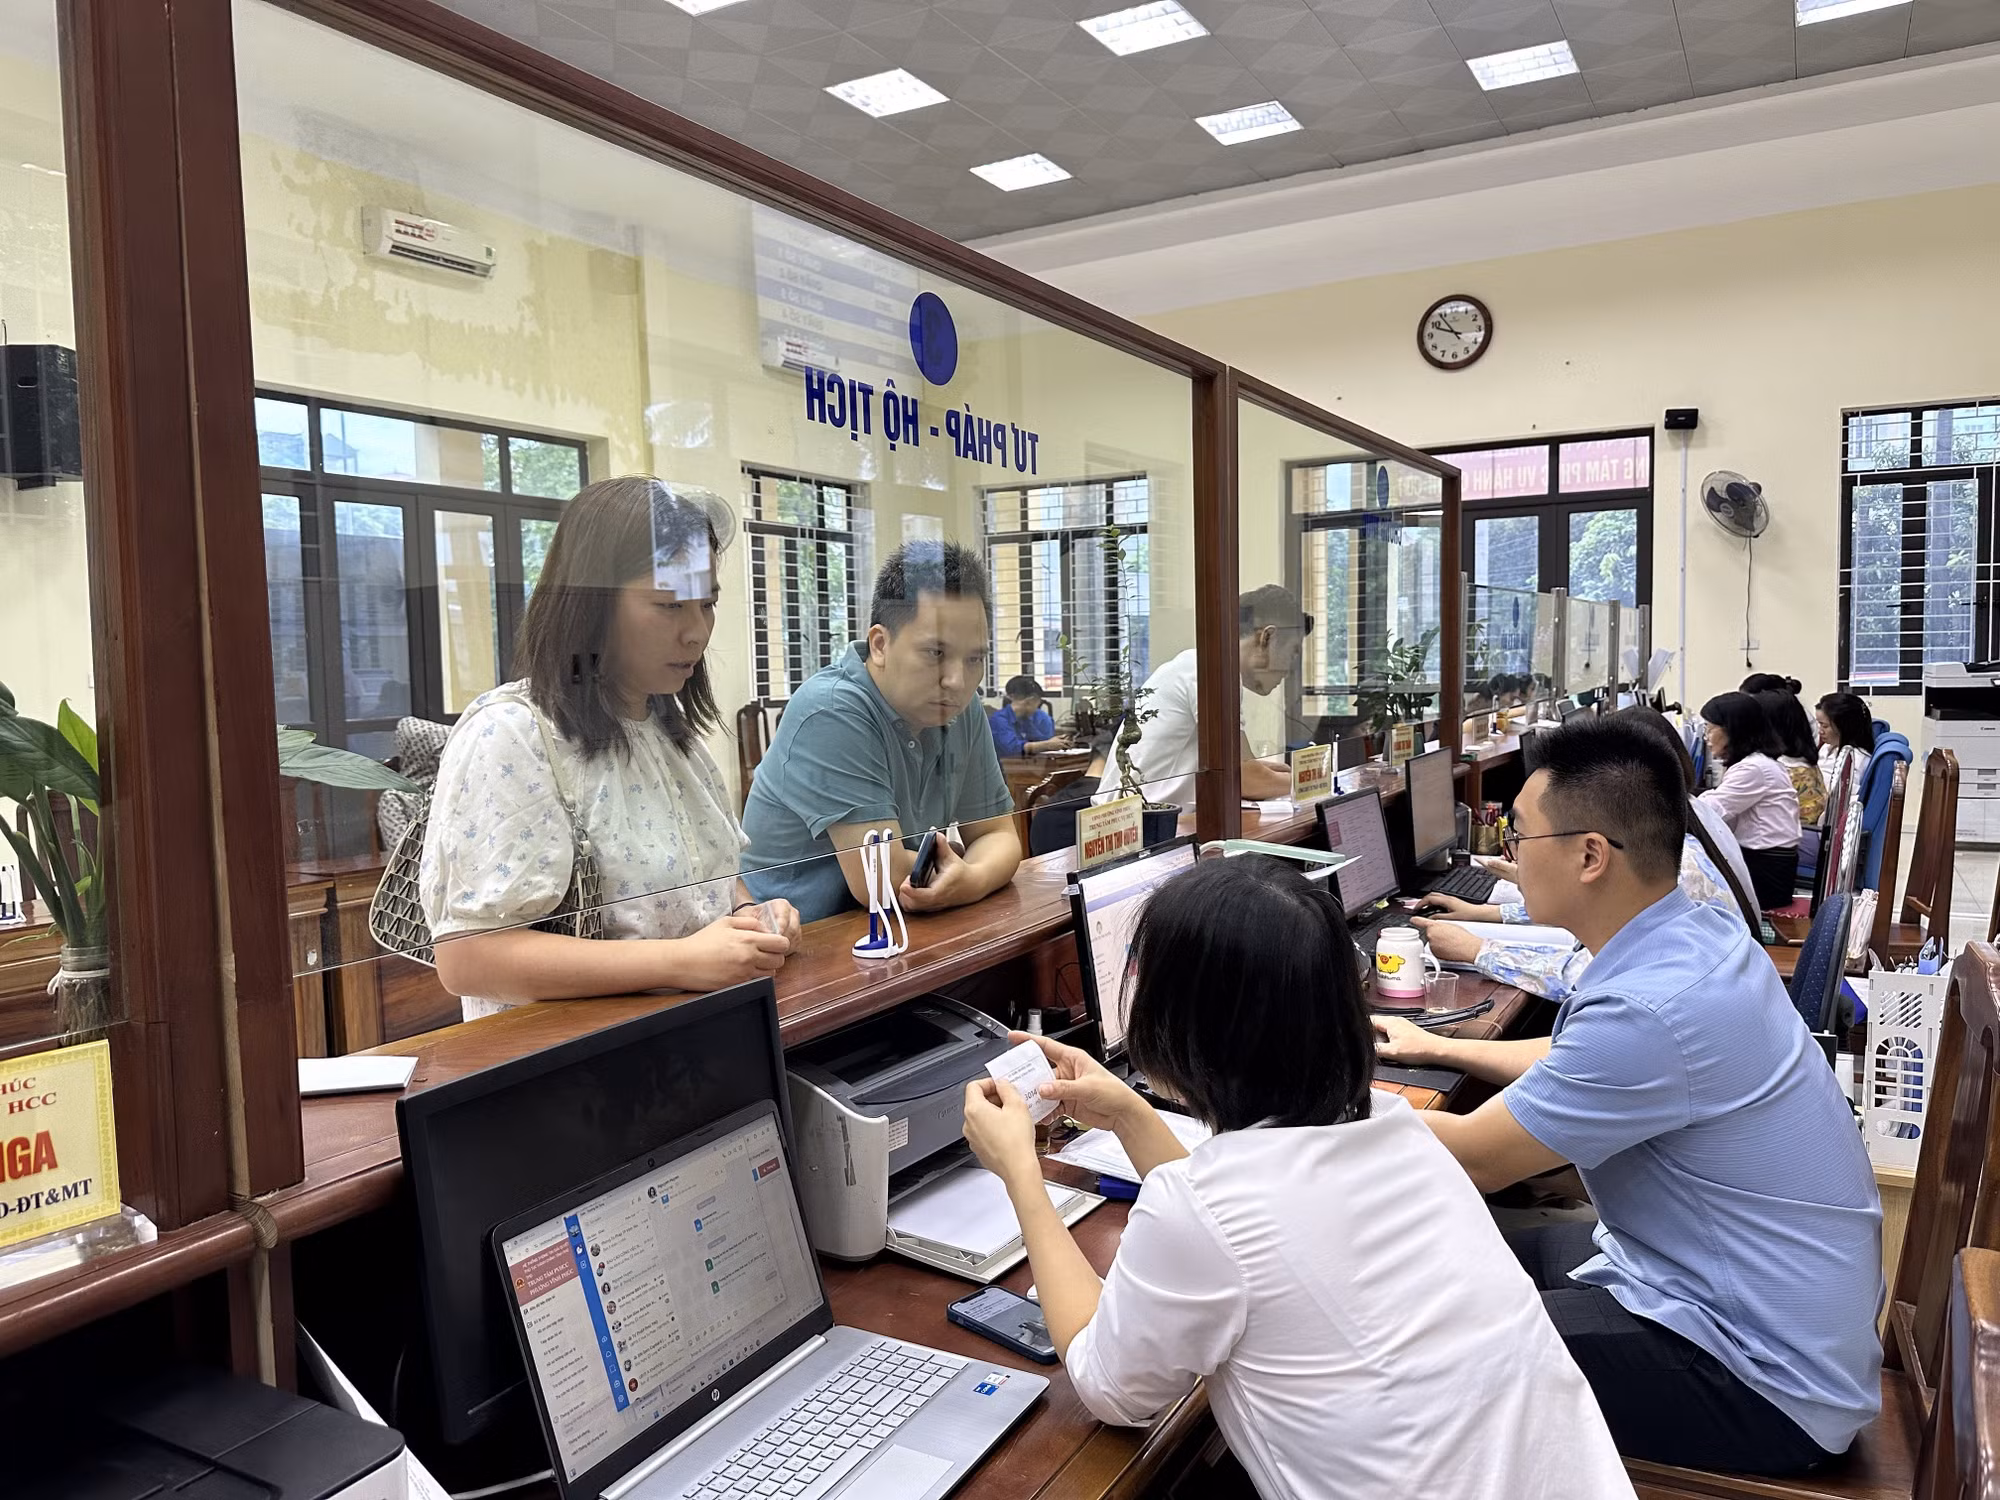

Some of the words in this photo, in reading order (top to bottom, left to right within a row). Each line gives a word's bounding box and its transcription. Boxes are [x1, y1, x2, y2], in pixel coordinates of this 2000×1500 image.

[1472, 314, 1478, 322] 2
[1431, 321, 1441, 329] 10
[1475, 325, 1482, 333] 3
[1427, 332, 1434, 340] 9
[1472, 337, 1478, 345] 4
[1431, 343, 1438, 351] 8
[1463, 346, 1470, 355] 5
[1440, 350, 1446, 358] 7
[1451, 351, 1458, 360] 6
[1085, 831, 1105, 860] NGUYỄN
[8, 1092, 57, 1115] HCC
[0, 1130, 58, 1184] GA
[711, 1388, 720, 1401] hp
